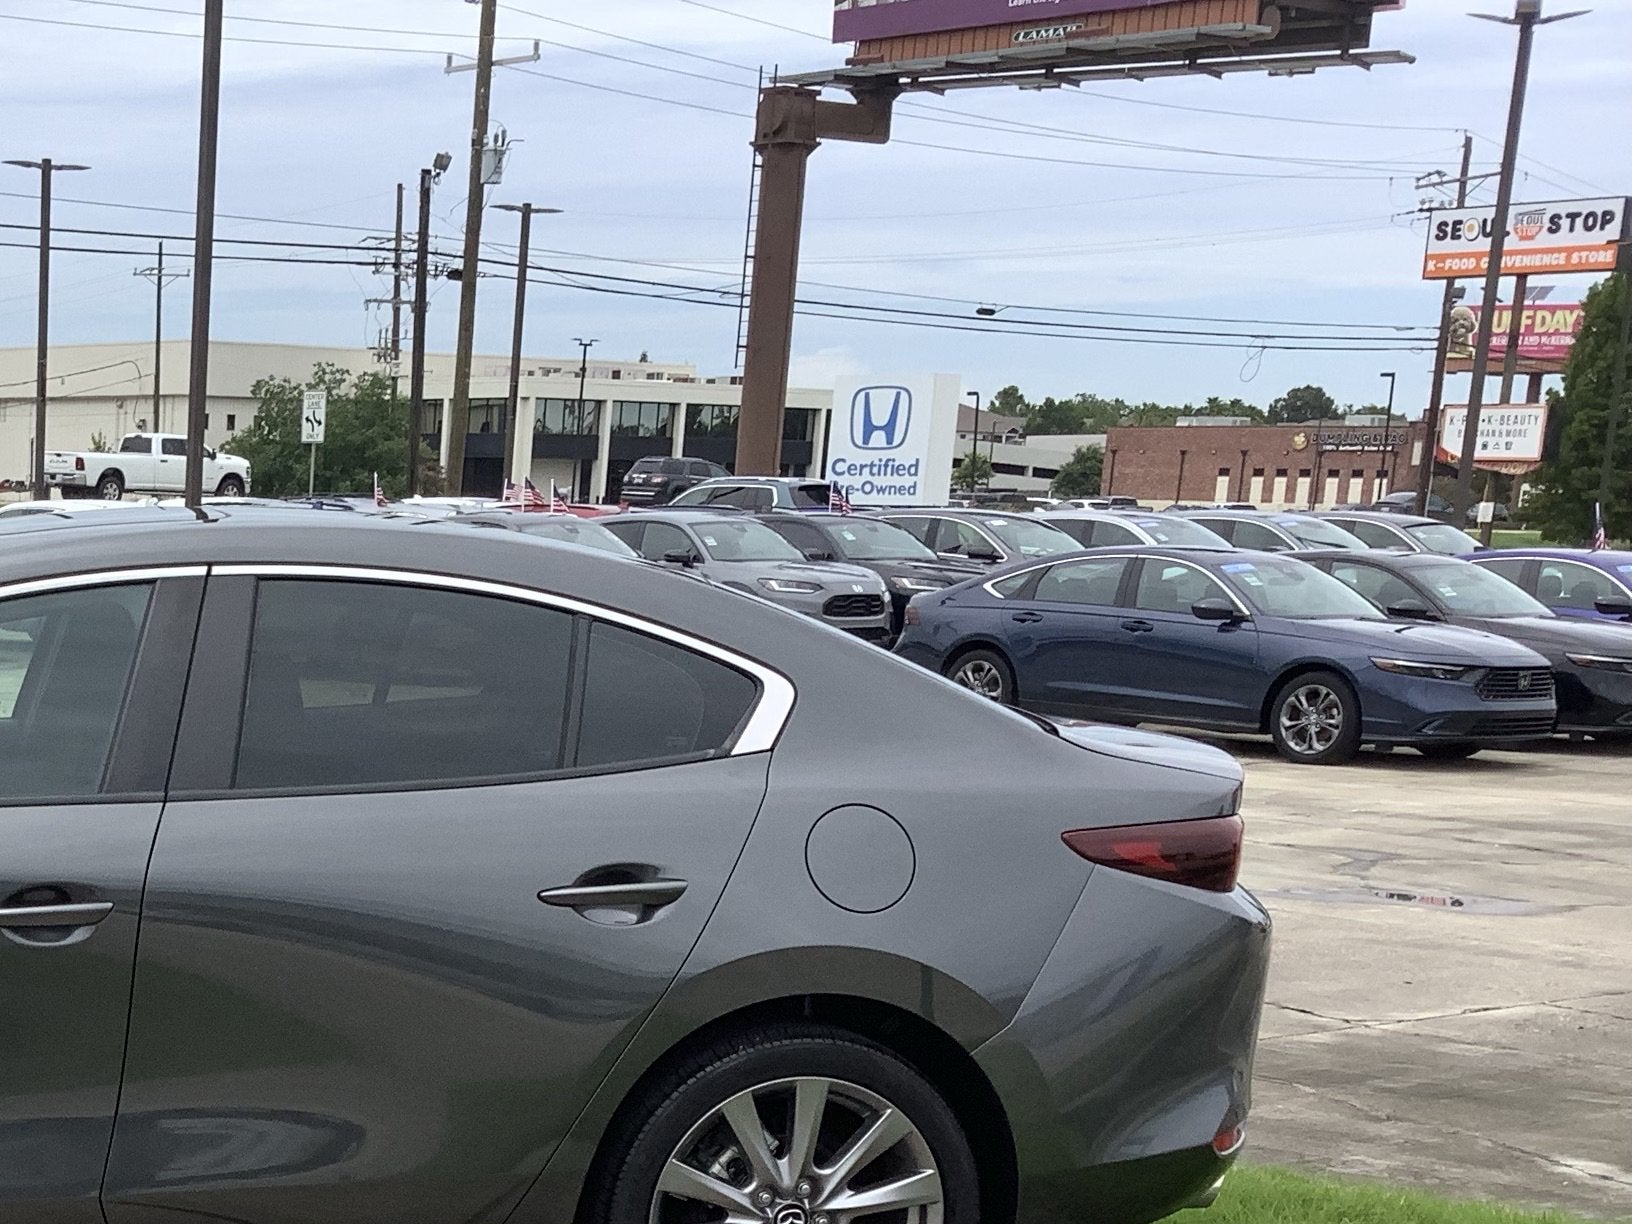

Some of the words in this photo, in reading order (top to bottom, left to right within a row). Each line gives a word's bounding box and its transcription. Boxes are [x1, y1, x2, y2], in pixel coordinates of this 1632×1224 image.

[1547, 210, 1616, 235] STOP
[1426, 256, 1476, 272] K-FOOD
[1570, 250, 1615, 264] STORE
[831, 458, 920, 477] Certified
